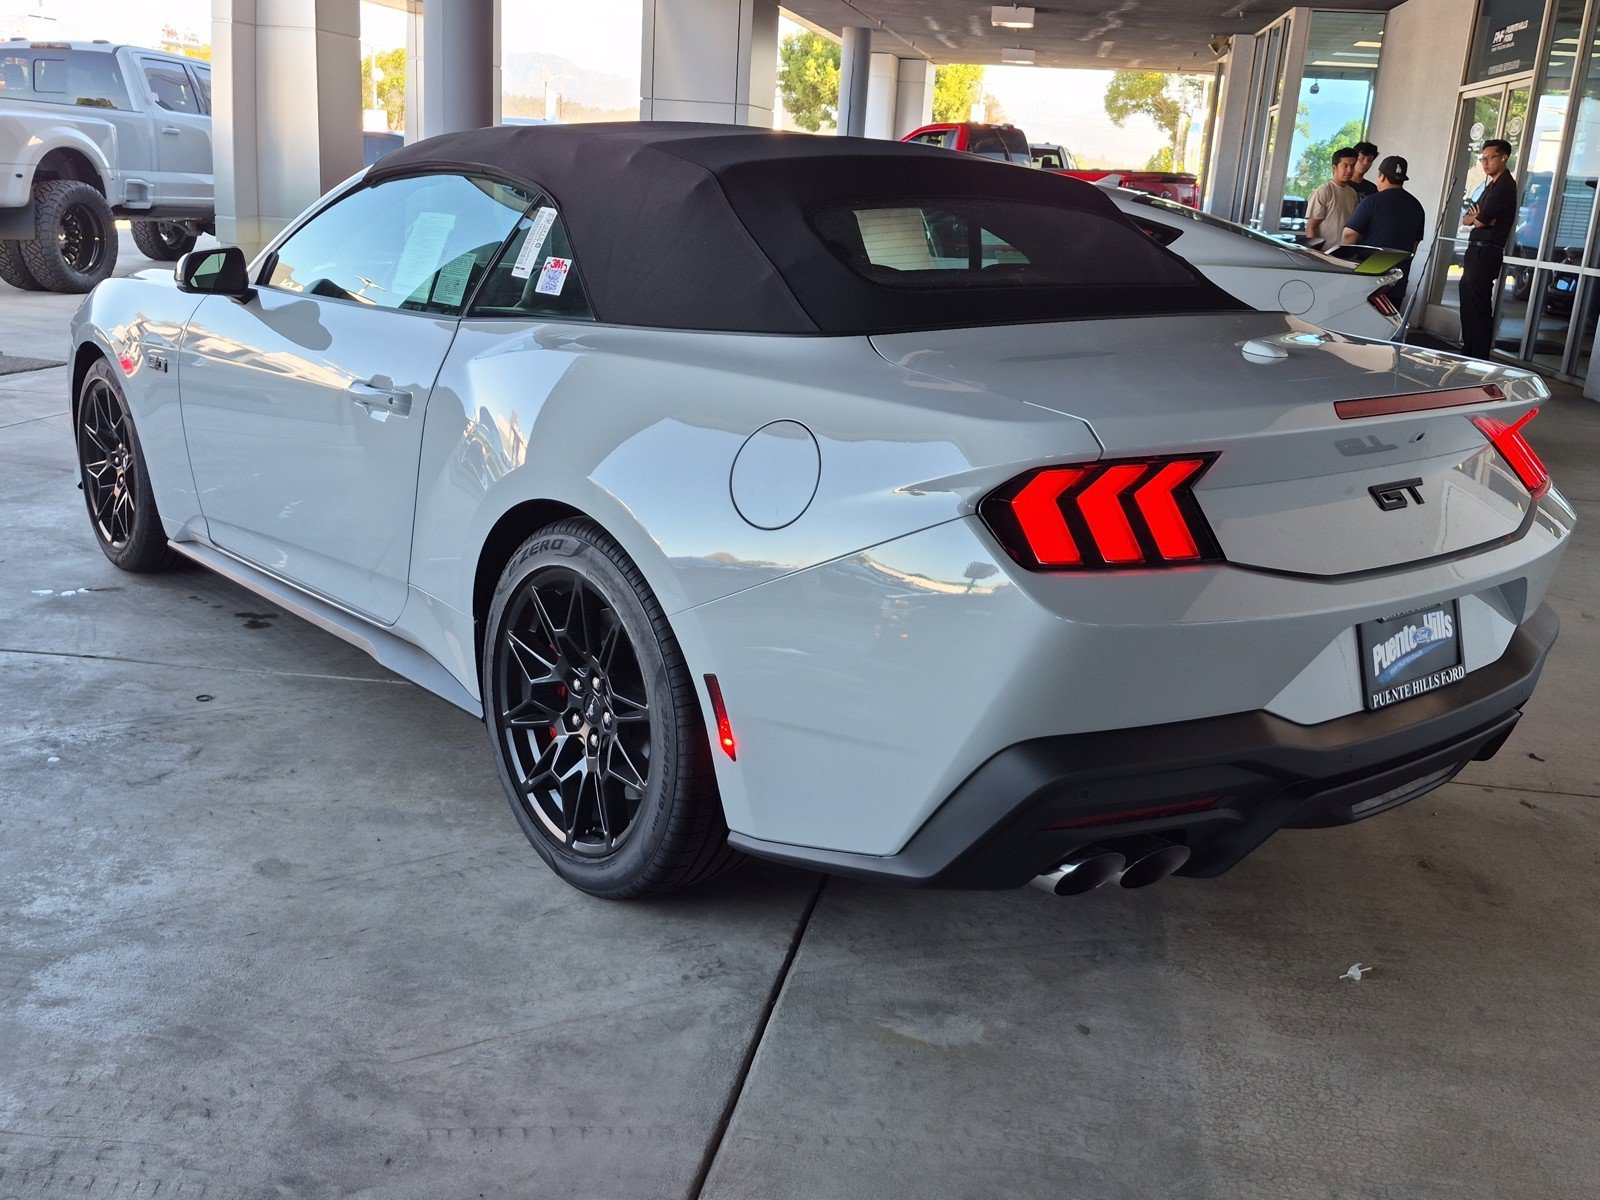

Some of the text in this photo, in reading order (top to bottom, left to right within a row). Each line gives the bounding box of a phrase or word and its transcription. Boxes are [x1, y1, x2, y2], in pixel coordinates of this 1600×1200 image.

[550, 258, 566, 270] 3M
[1367, 477, 1425, 512] GT
[520, 538, 565, 565] ZERO
[1372, 624, 1418, 678] Puente
[1423, 610, 1453, 643] Hills
[1372, 665, 1465, 709] PUENTE HILLS FORD
